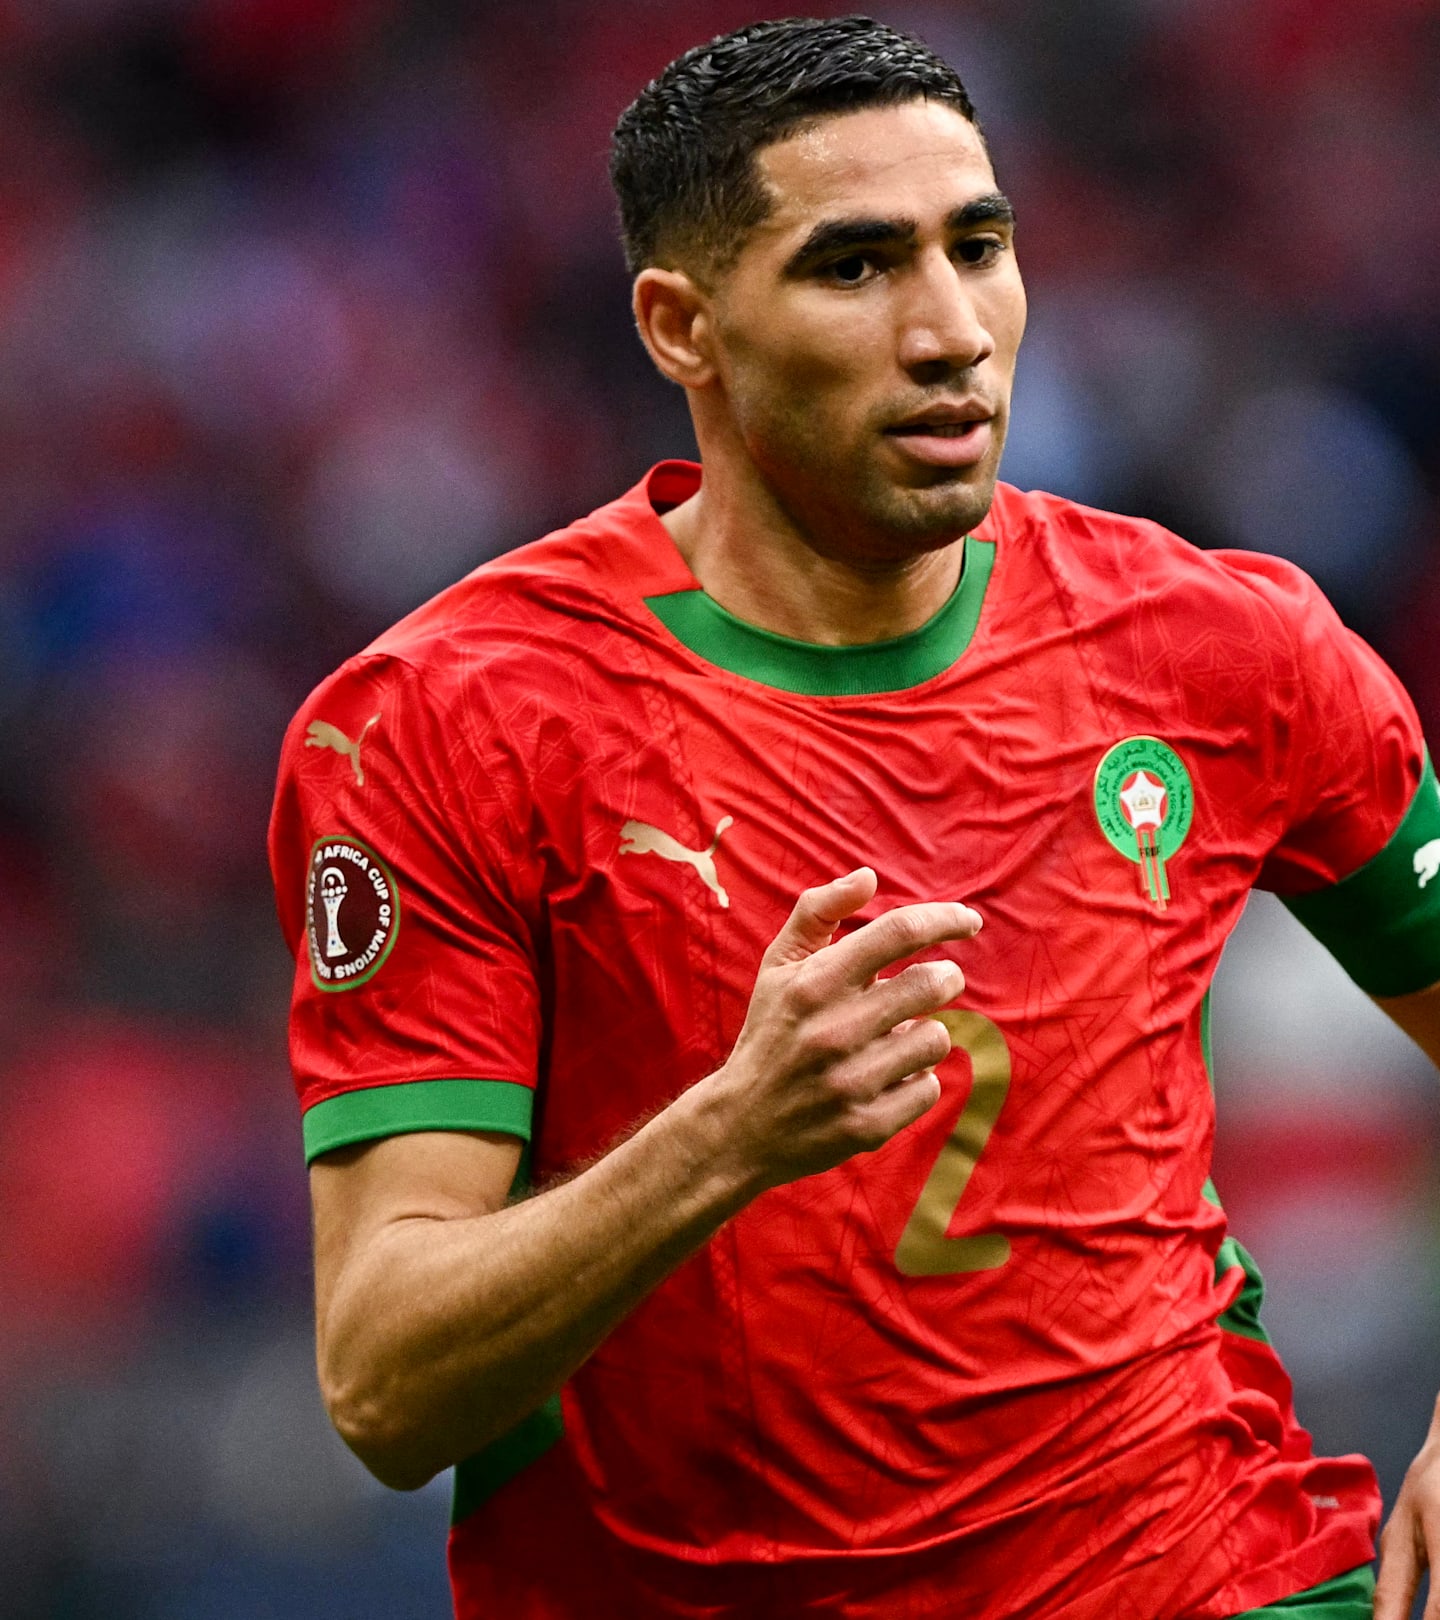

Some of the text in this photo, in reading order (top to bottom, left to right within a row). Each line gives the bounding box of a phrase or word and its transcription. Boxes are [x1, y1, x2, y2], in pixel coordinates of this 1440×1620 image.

[324, 845, 391, 979] AFRICA CUP OF NATIONS
[894, 1009, 1012, 1277] 2
